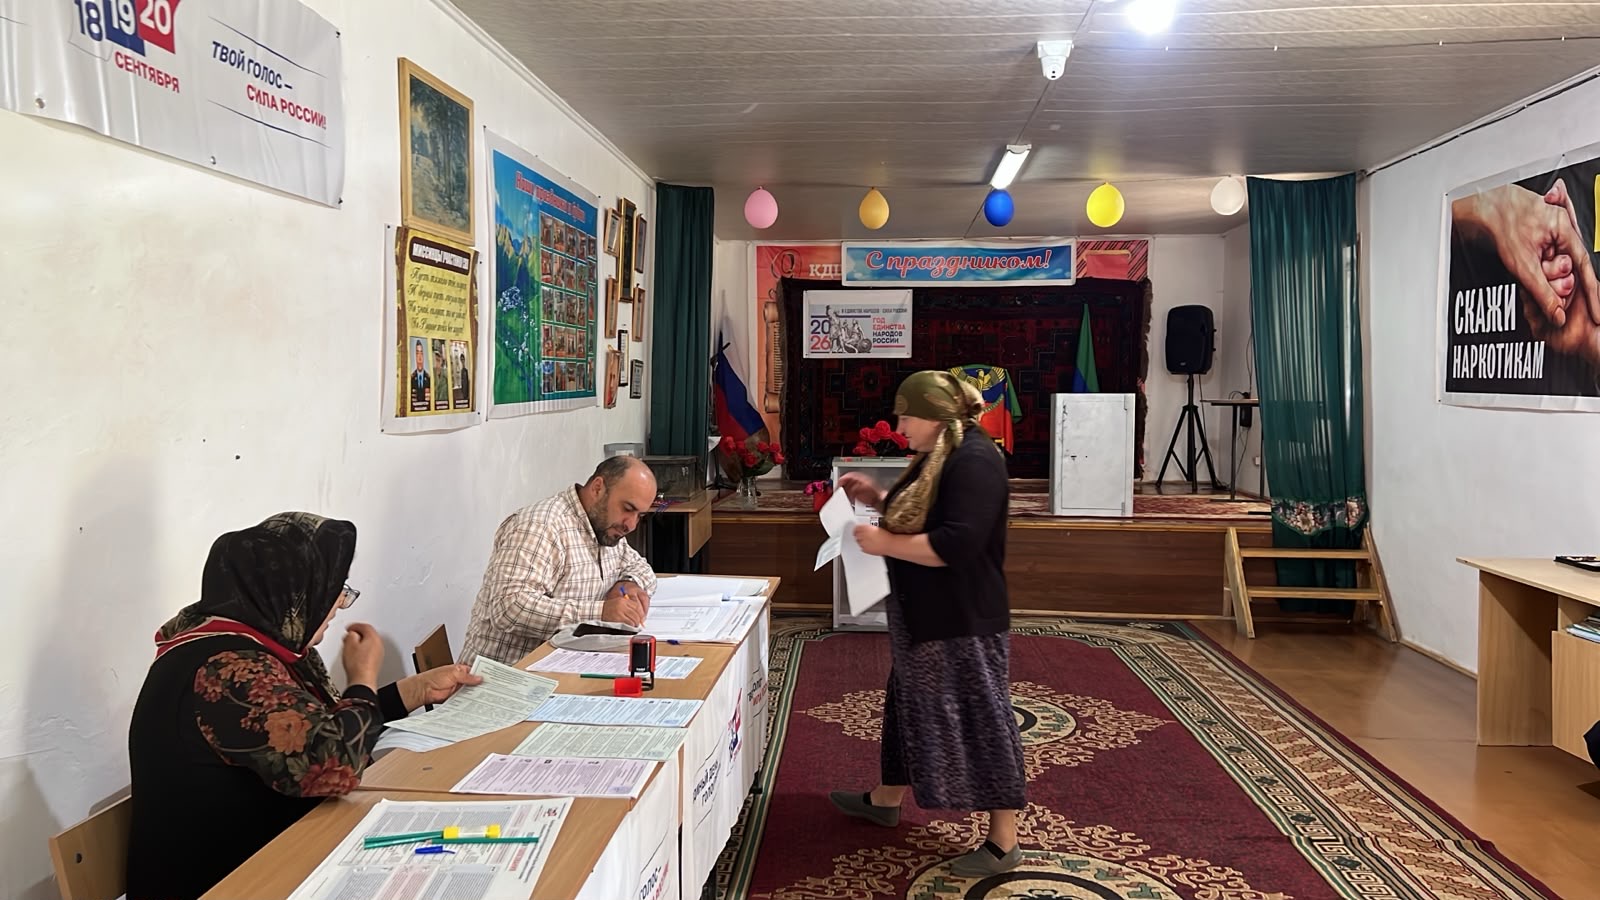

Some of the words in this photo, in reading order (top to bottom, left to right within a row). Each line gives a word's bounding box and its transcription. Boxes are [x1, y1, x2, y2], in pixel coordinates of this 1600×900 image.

[74, 0, 103, 42] 18
[110, 0, 137, 36] 19
[114, 51, 180, 94] СЕНТЯБРЯ
[212, 40, 245, 71] ТВОЙ
[247, 58, 282, 89] ГОЛОС
[246, 84, 279, 112] СИЛА
[280, 98, 327, 130] РОССИИ!
[865, 251, 884, 269] С
[887, 249, 1052, 278] праздником!
[810, 320, 832, 334] 20
[1454, 283, 1516, 335] СКАЖИ
[810, 335, 832, 350] 26
[1452, 341, 1545, 379] НАРКОТИКАМ
